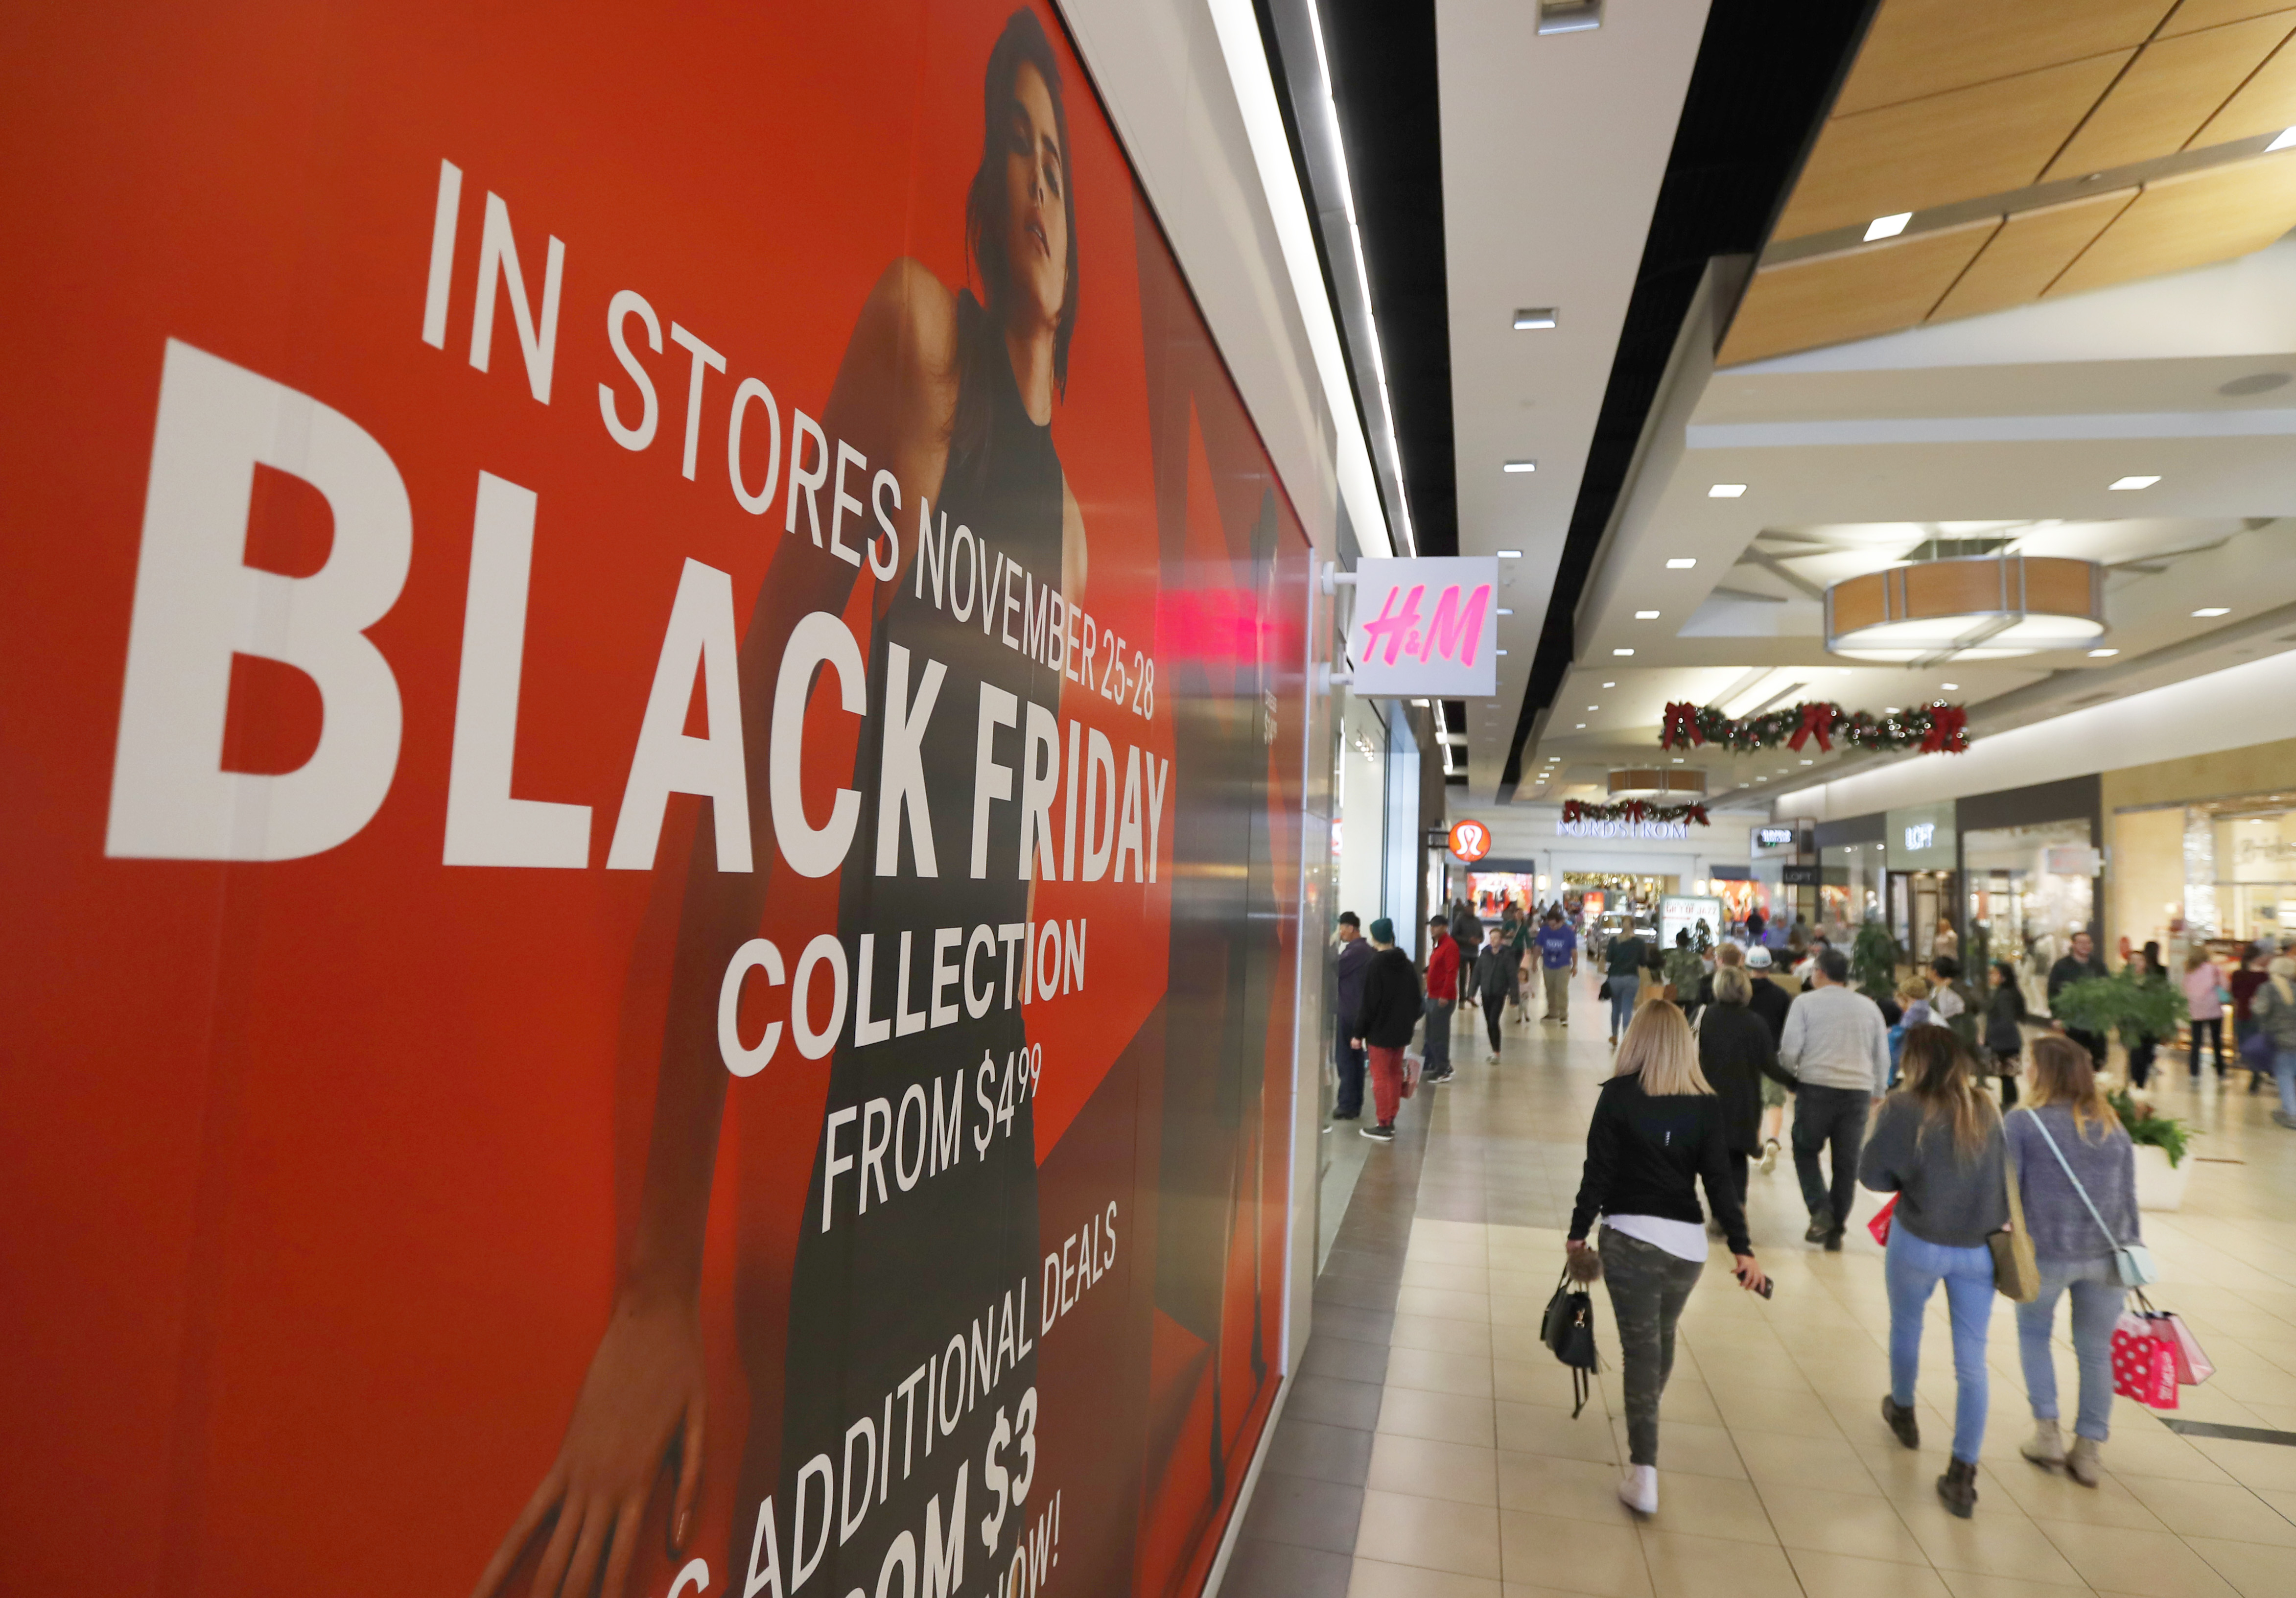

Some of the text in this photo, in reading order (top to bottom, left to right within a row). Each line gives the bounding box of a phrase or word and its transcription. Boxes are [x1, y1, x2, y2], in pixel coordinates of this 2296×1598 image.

[422, 158, 1154, 721] IN STORES NOVEMBER 25-28
[104, 336, 1169, 883] BLACK FRIDAY
[1362, 584, 1492, 667] H&M
[1556, 820, 1688, 839] NORDSTROM
[717, 918, 1087, 1078] COLLECTION
[821, 1068, 963, 1234] FROM
[743, 1200, 1118, 1598] ADDITIONAL DEALS
[981, 1386, 1038, 1559] $3
